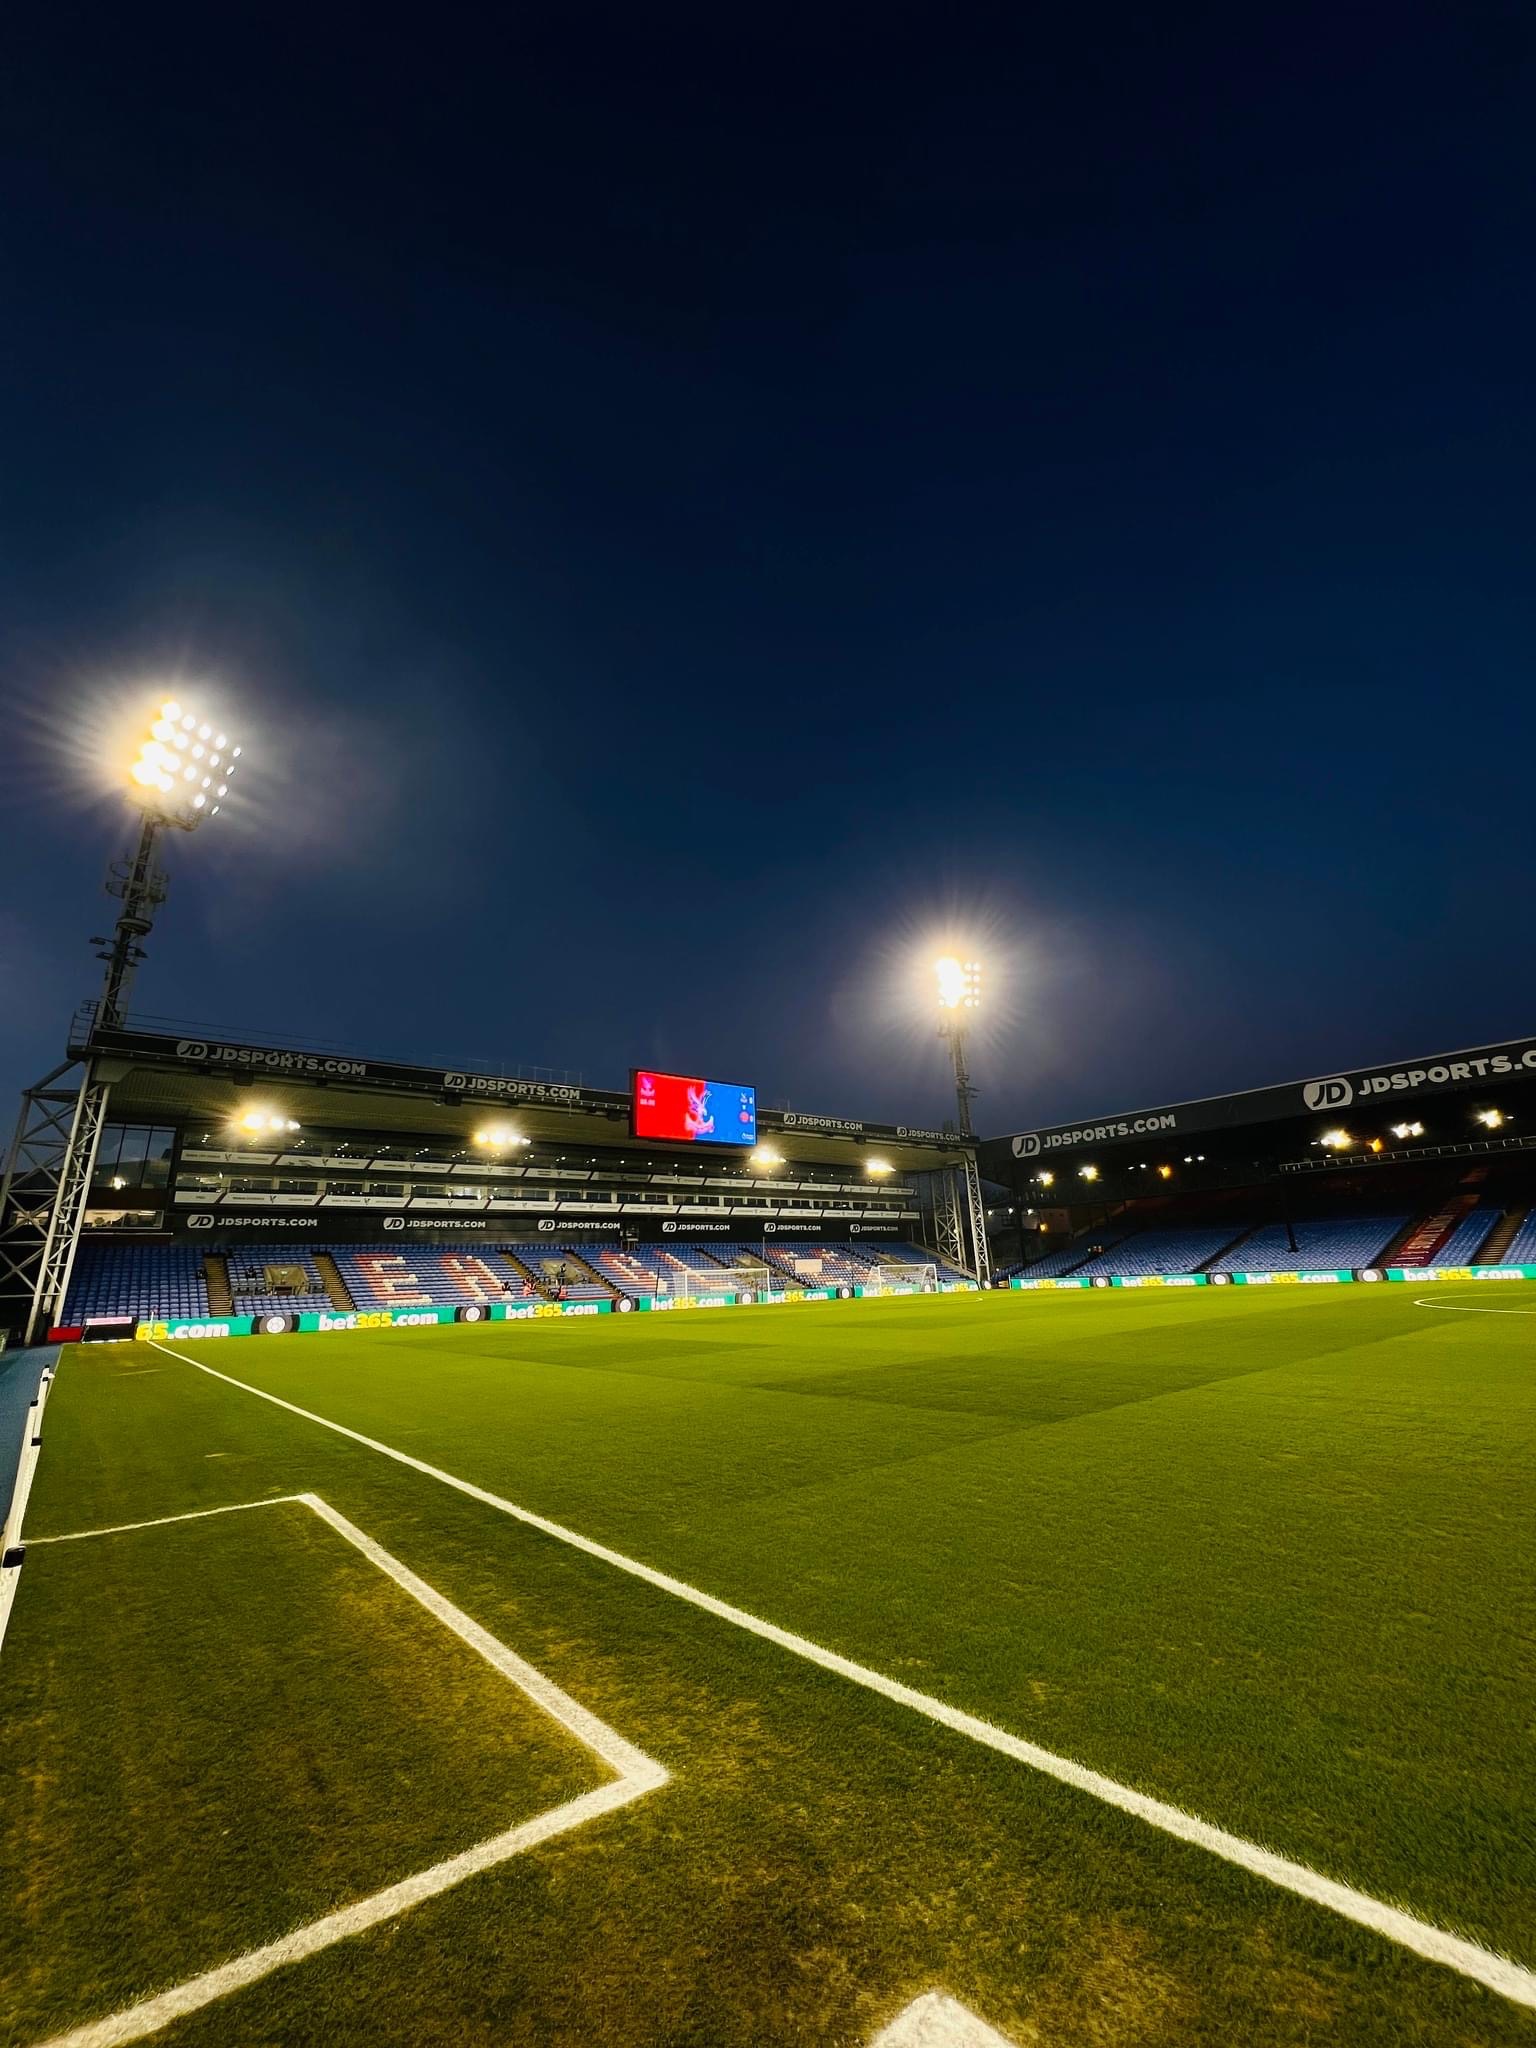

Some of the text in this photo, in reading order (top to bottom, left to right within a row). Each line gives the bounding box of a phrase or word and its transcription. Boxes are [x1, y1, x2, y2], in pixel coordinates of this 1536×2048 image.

[210, 1047, 366, 1075] JDSPORTS.COM
[468, 1078, 580, 1099] JDSPORTS.COM
[1308, 1080, 1349, 1108] JD
[797, 1117, 862, 1131] JDSPORTS.COM
[908, 1130, 960, 1141] JDSPORTS.COM
[1014, 1114, 1176, 1156] JD JDSPORTS.COM
[189, 1216, 318, 1227] JD JDSPORTS.COM
[386, 1218, 486, 1229] JD JDSPORTS.COM
[1122, 1275, 1195, 1288] bet365.com
[1247, 1271, 1339, 1285] bet365.com
[1403, 1267, 1525, 1282] bet365.com
[505, 1303, 599, 1320] bet365.com
[319, 1312, 439, 1332] bet365.com
[135, 1322, 230, 1341] 65.com
